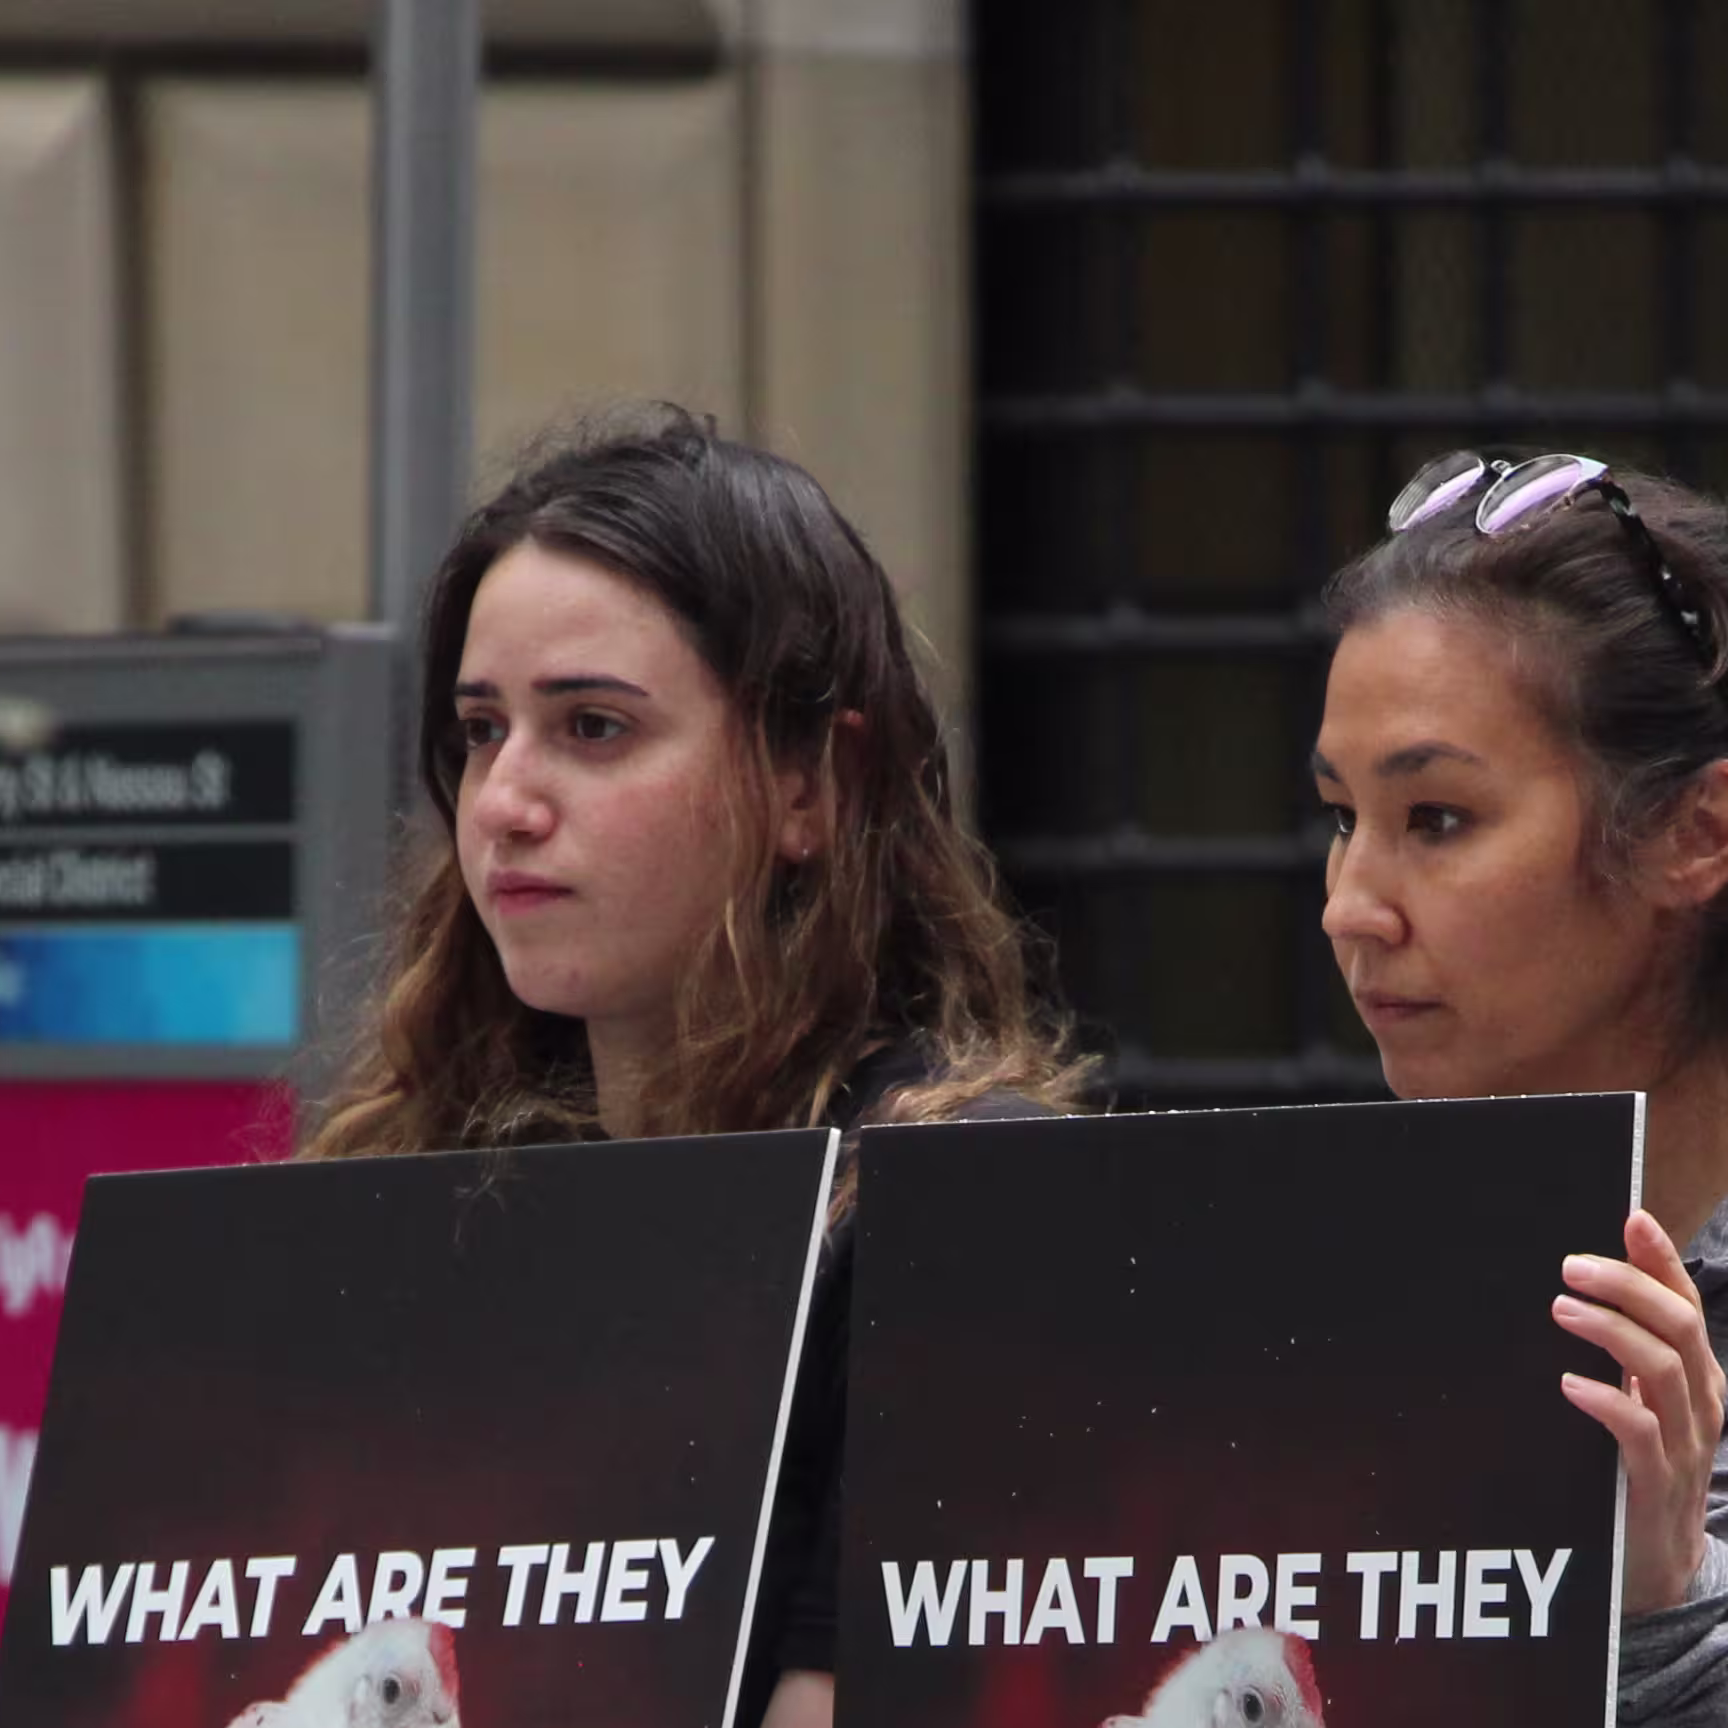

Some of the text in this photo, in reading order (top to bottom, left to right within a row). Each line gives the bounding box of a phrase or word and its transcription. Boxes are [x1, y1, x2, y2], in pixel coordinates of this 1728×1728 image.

[50, 1536, 716, 1645] WHAT ARE THEY
[881, 1548, 1573, 1647] WHAT ARE THEY
